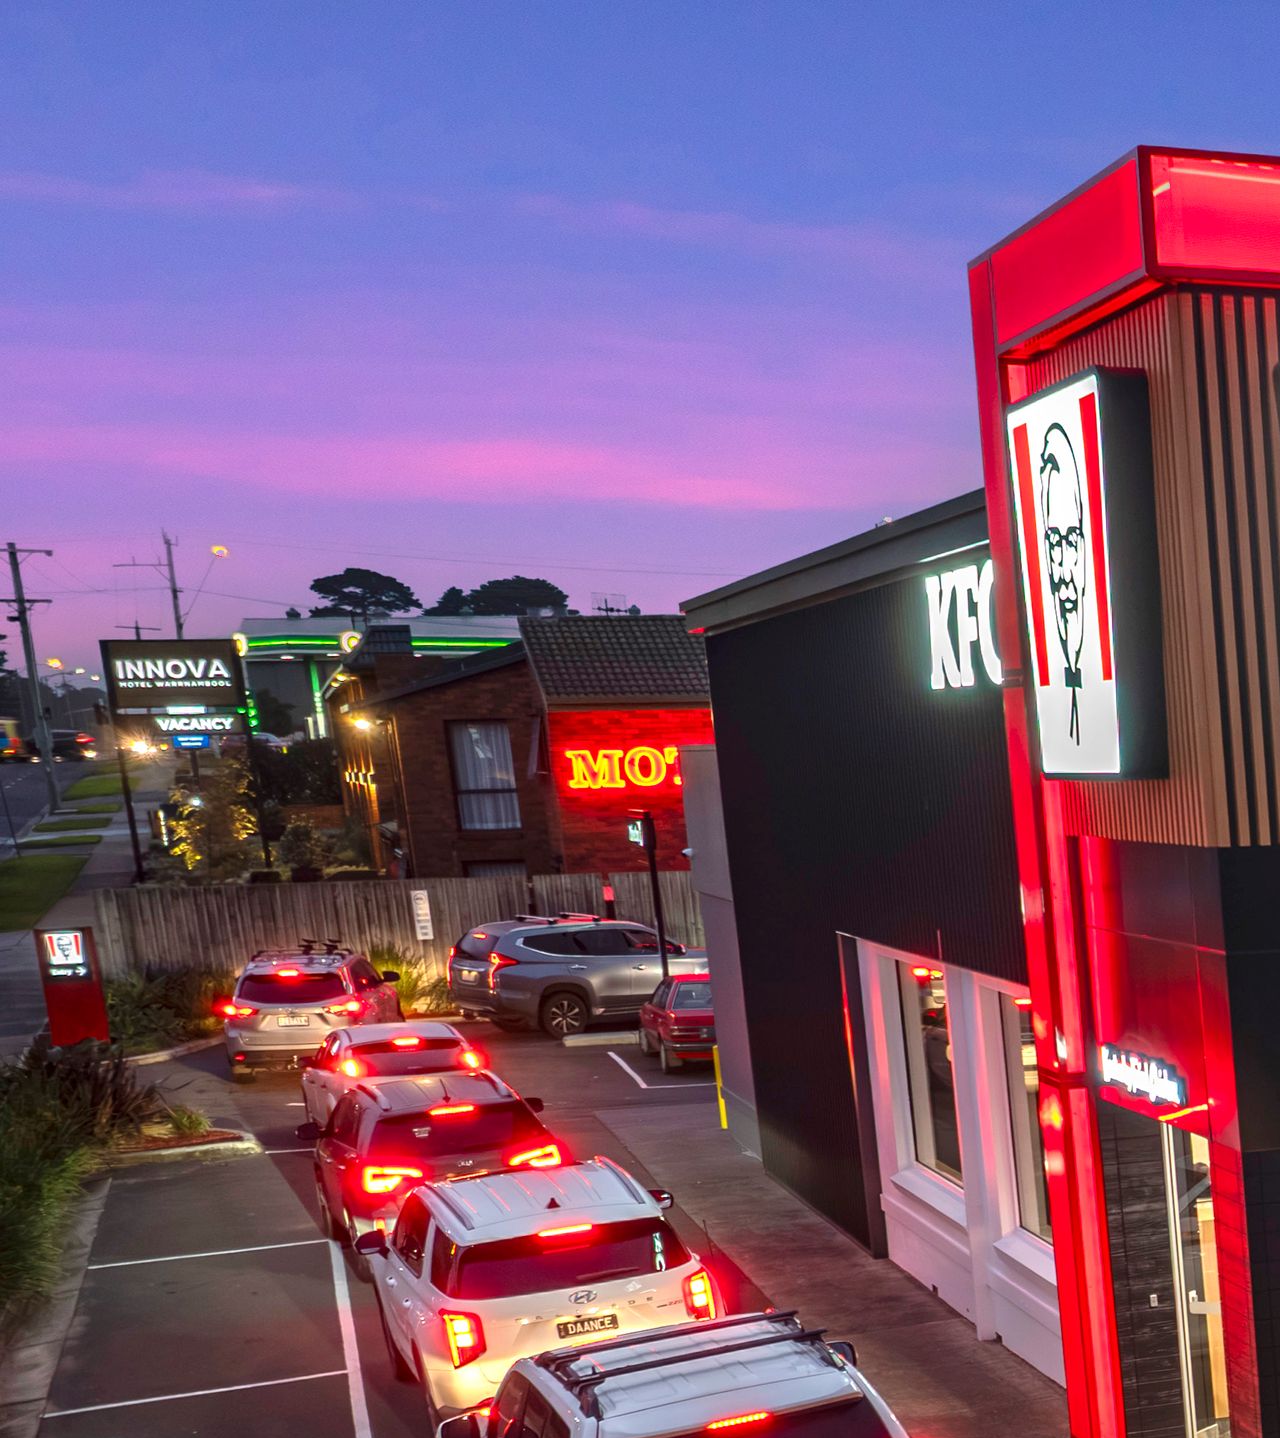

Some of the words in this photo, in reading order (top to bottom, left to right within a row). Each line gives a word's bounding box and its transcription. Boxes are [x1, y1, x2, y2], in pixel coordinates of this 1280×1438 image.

[925, 559, 1003, 689] KFC
[115, 658, 231, 680] INNOVA
[118, 680, 152, 688] MOTEL
[156, 717, 233, 731] VACANCY
[568, 1317, 613, 1334] DAANCE
